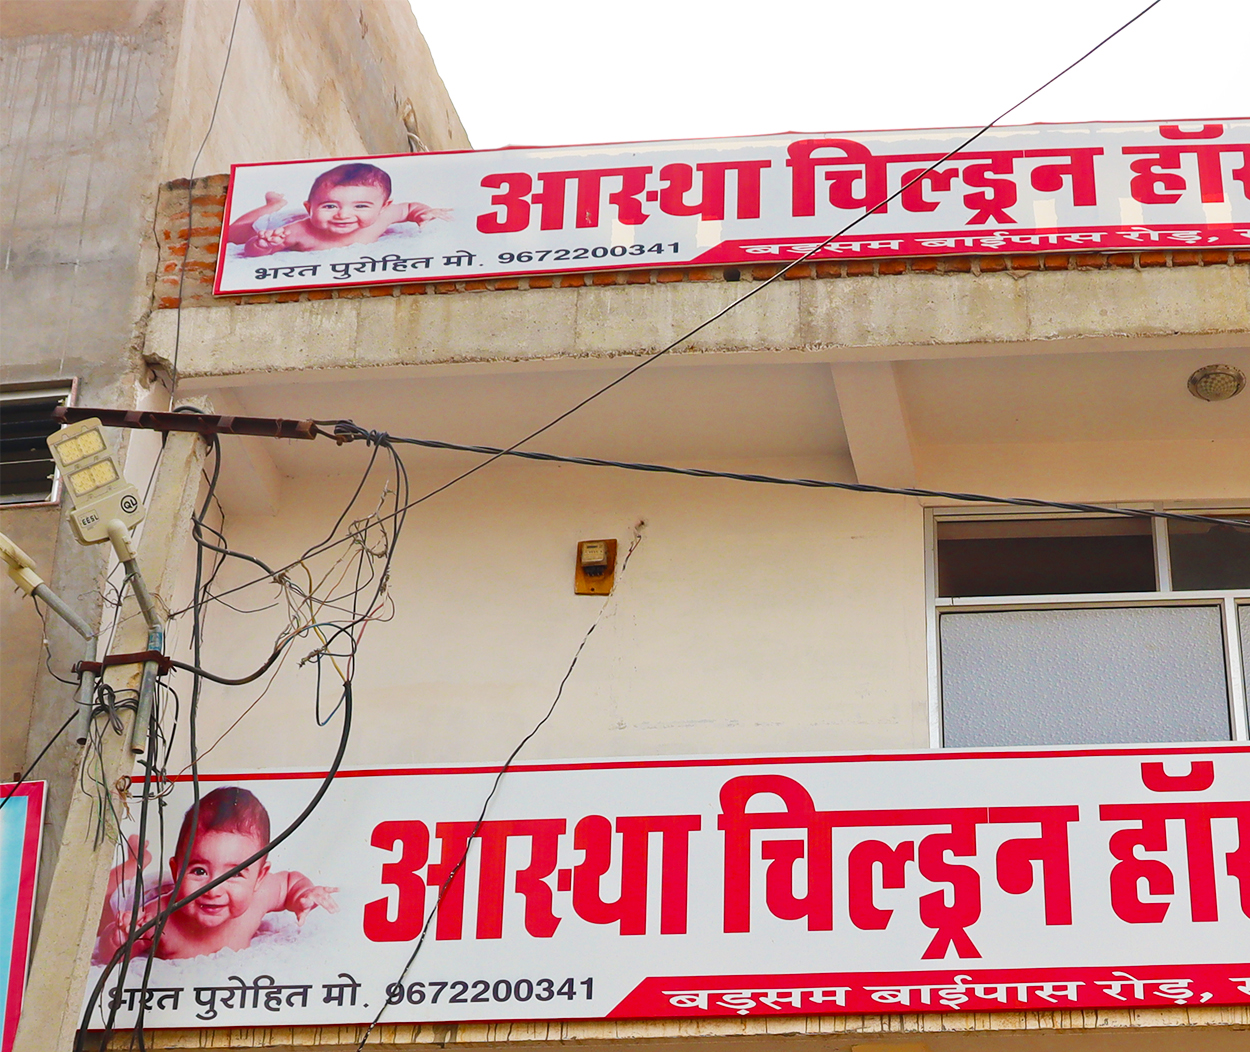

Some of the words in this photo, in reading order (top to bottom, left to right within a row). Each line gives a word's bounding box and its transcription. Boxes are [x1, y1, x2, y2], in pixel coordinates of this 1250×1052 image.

[476, 159, 772, 233] आस्था
[786, 139, 1103, 226] चिल्ड्रन
[255, 265, 321, 279] भरत
[330, 254, 434, 280] पुरोहित
[443, 250, 482, 266] मो.
[498, 242, 681, 264] 9672200341
[914, 231, 1108, 249] बाईपास
[363, 815, 701, 942] आस्था
[718, 775, 1079, 959] चिल्ड्रन
[193, 975, 312, 1020] पुरोहित
[322, 973, 368, 1007] मो.
[386, 974, 600, 1006] 9672200341
[662, 987, 851, 1015] बड़सम
[863, 975, 1085, 1009] बाईपास
[1094, 972, 1213, 1004] रोड़,
